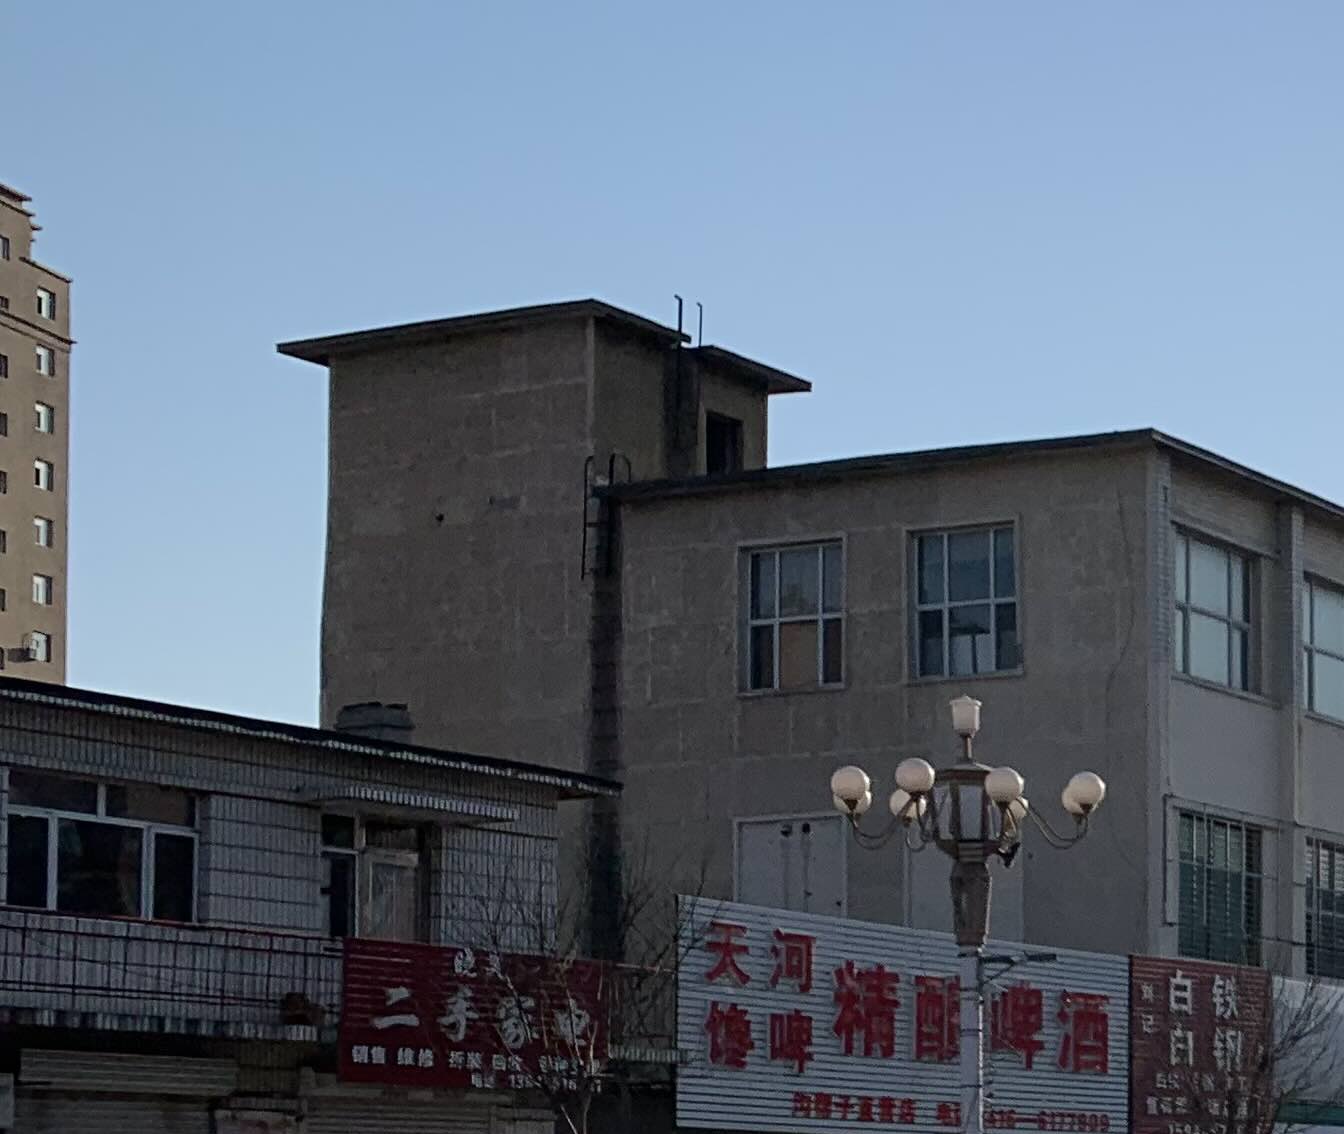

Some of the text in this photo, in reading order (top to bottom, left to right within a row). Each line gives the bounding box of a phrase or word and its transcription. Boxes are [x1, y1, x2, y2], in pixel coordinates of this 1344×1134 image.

[704, 919, 818, 993] 天河
[832, 959, 1112, 1075] 精酿啤酒
[1168, 969, 1240, 1019] 白铁
